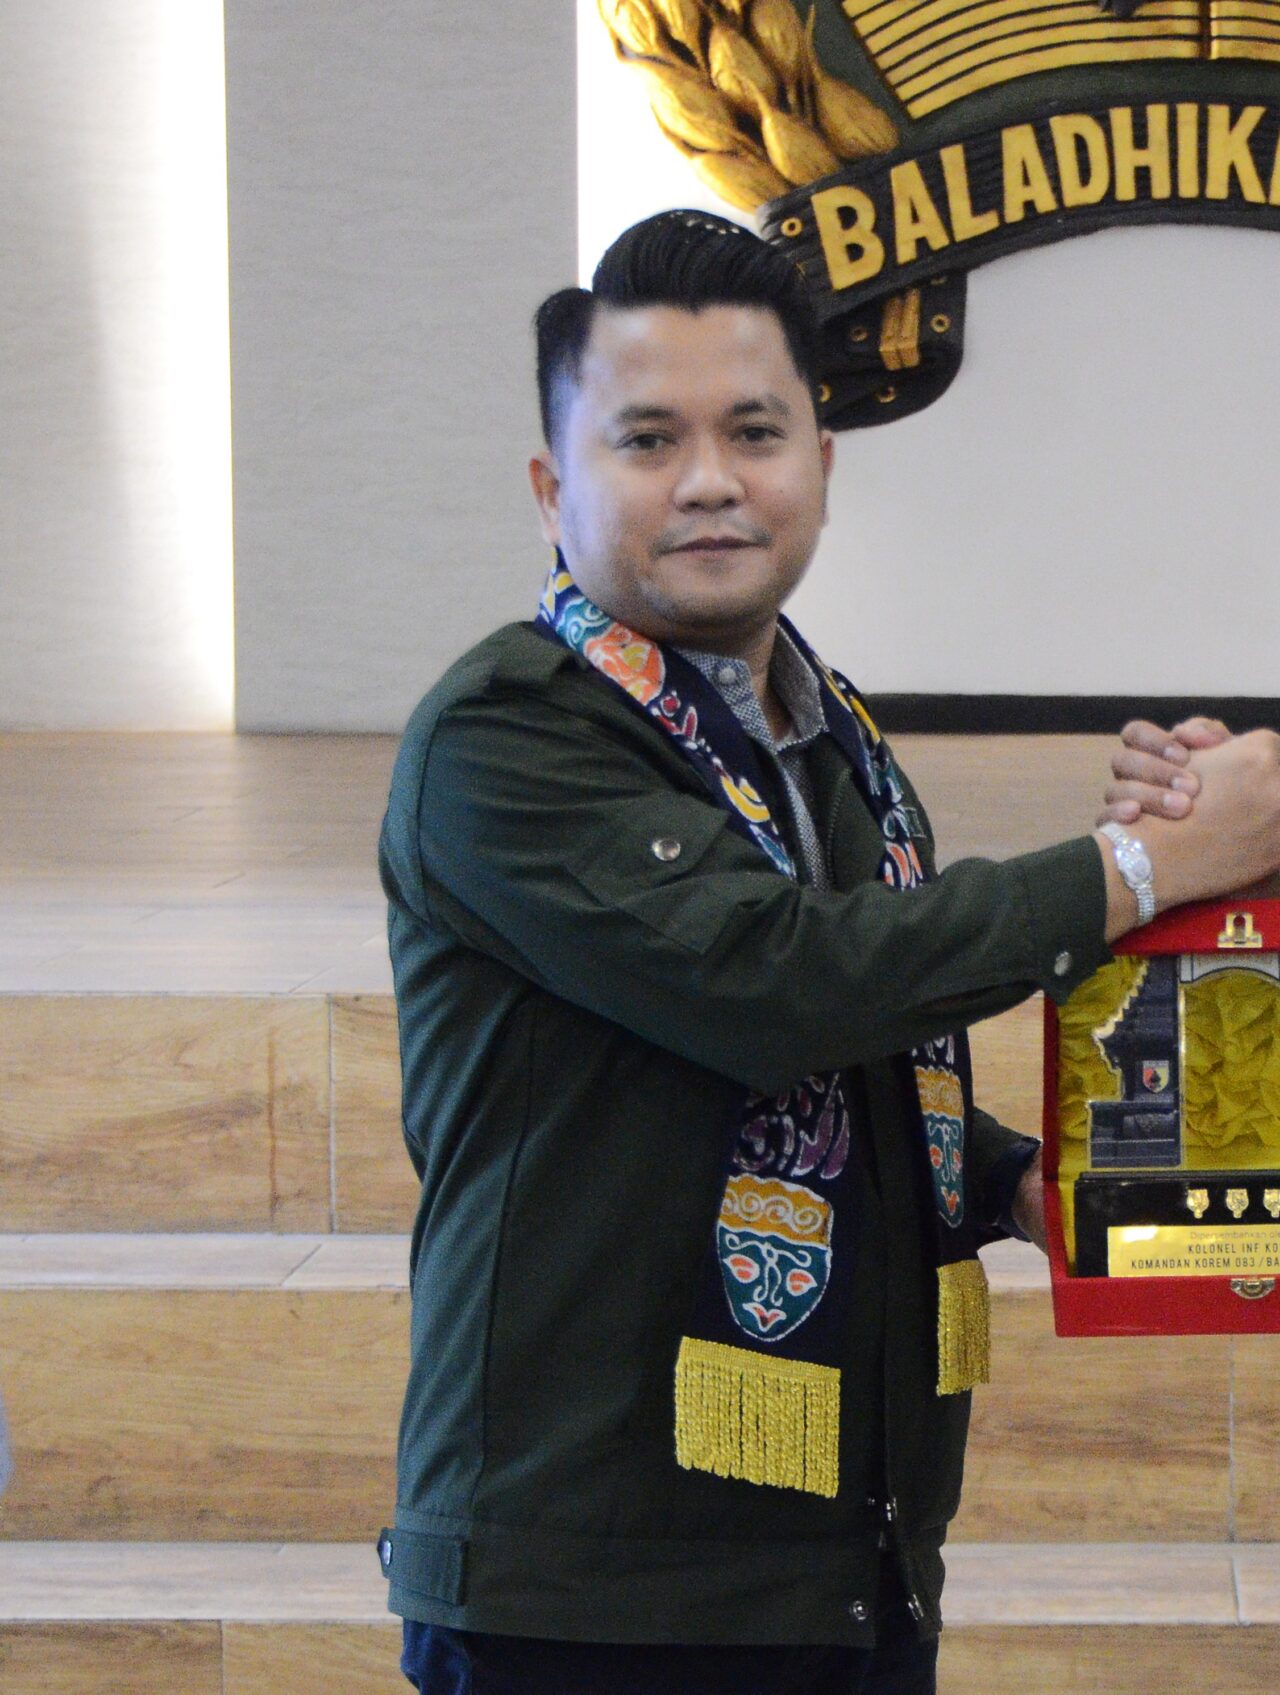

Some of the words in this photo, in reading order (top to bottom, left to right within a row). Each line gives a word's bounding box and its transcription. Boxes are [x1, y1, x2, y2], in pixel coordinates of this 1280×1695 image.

[1187, 1243, 1237, 1255] KOLONEL
[1241, 1243, 1259, 1254] INF
[1131, 1258, 1190, 1270] KOMANDAN
[1195, 1257, 1230, 1269] KOREM
